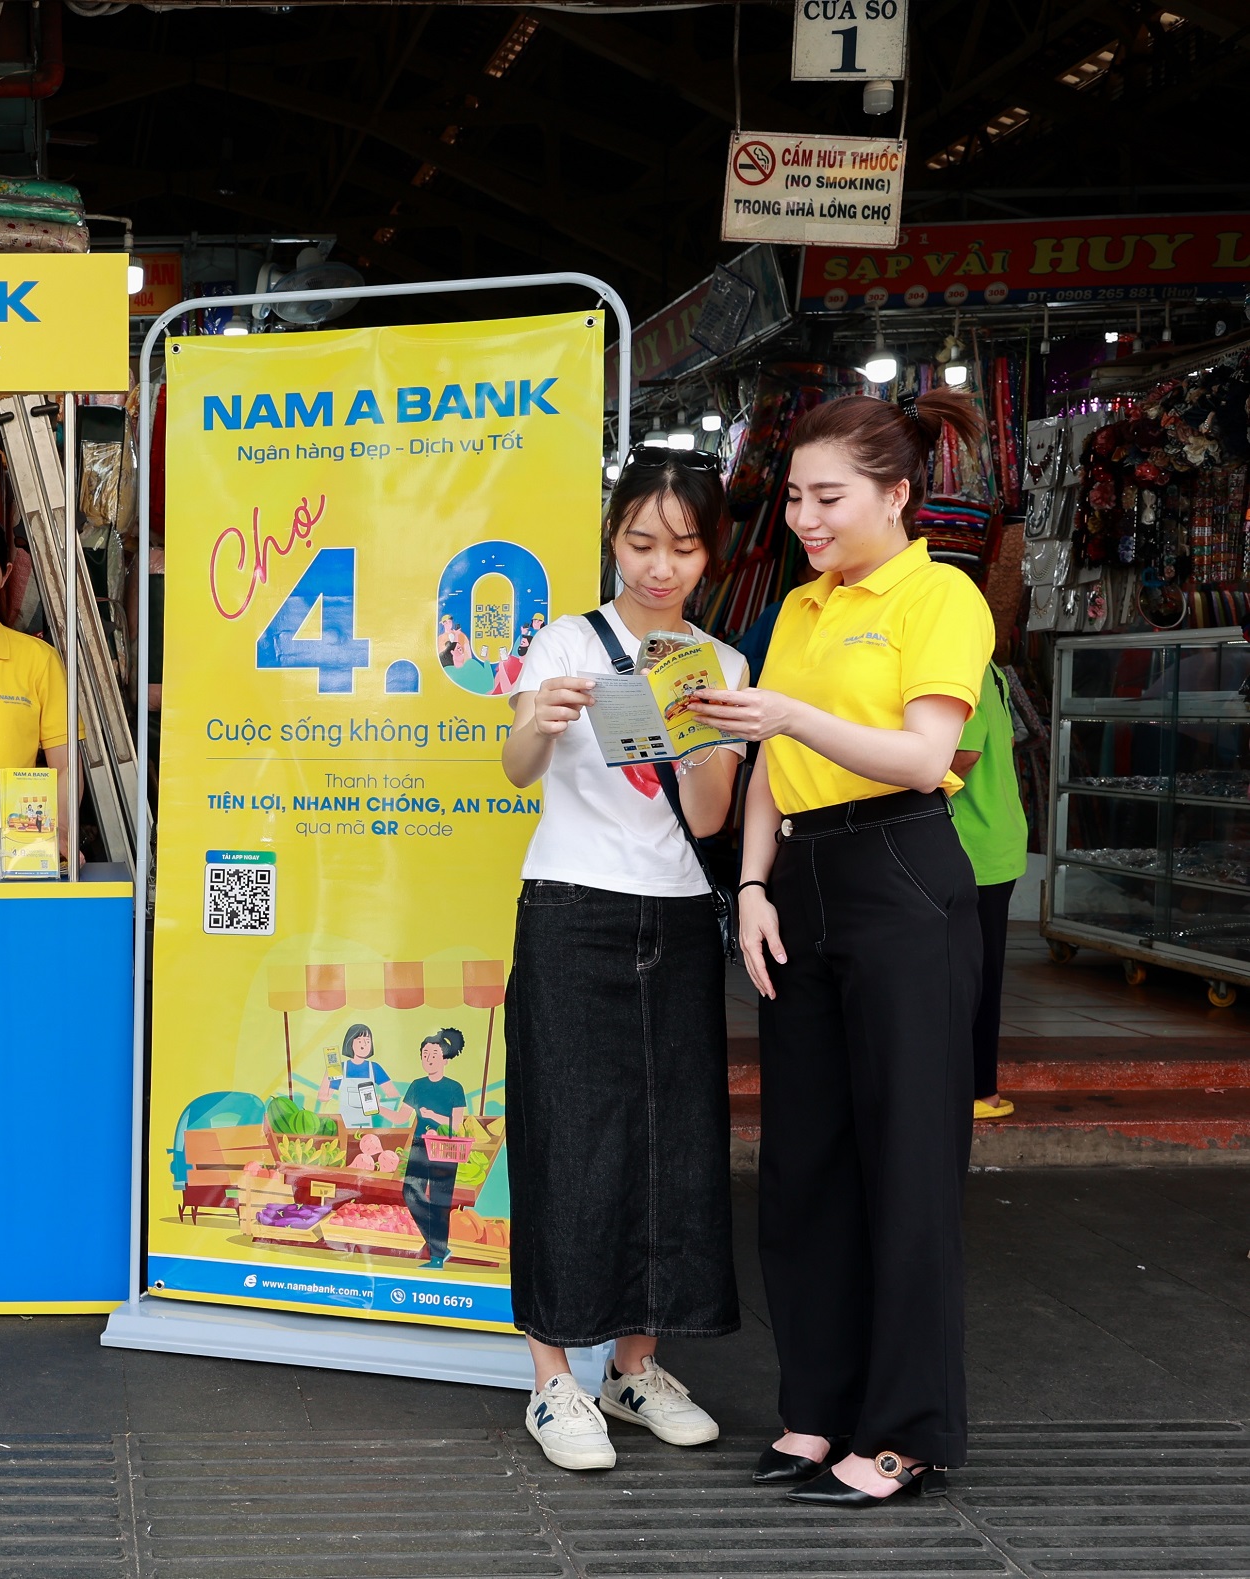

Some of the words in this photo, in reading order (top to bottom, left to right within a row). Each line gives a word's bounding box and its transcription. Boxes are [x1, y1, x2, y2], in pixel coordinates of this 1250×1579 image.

[830, 25, 867, 73] 1
[781, 141, 813, 167] CẤM
[816, 145, 846, 169] HÚT
[850, 146, 899, 172] THUỐC
[785, 174, 811, 190] (NO
[815, 176, 891, 194] SMOKING)
[733, 199, 781, 216] TRONG
[785, 198, 815, 217] NHÀ
[819, 197, 857, 220] LỒNG
[861, 203, 892, 225] CHỢ
[823, 253, 914, 285] SẠP
[923, 239, 1012, 277] VẢI
[1028, 233, 1196, 274] HUY
[134, 292, 154, 307] 404
[828, 295, 845, 303] 301
[868, 293, 885, 301] 302
[947, 290, 965, 298] 306
[988, 289, 1006, 297] 308
[1027, 291, 1052, 301] ĐT:
[1056, 289, 1093, 301] 0908
[1097, 288, 1125, 300] 265
[1129, 287, 1156, 299] 881
[1162, 286, 1198, 298] (Huy)
[203, 391, 333, 431] NAM
[344, 389, 385, 426] A
[396, 377, 561, 424] BANK
[237, 444, 290, 464] Ngân
[296, 442, 345, 462] hàng
[350, 441, 391, 460] Đẹp
[409, 437, 454, 457] Dịch
[459, 439, 484, 455] vụ
[487, 430, 523, 451] Tốt
[209, 494, 326, 620] Chợ
[255, 539, 550, 697] 4.0
[654, 660, 671, 675] NAM
[677, 647, 702, 658] BANK
[206, 718, 272, 746] Cuộc
[280, 716, 342, 747] sống
[350, 718, 429, 747] không
[437, 716, 486, 742] tiền
[325, 773, 377, 789] Thanh
[383, 772, 425, 789] toán
[207, 791, 245, 814] TIỆN
[251, 793, 286, 815] LỢI,
[293, 796, 360, 812] NHANH
[366, 793, 446, 815] CHÓNG,
[452, 798, 479, 813] AN
[296, 821, 331, 836] qua
[336, 819, 365, 835] mã
[371, 820, 399, 836] QR
[404, 820, 453, 837] code
[262, 1279, 374, 1298] www.namabank.com.vn
[411, 1292, 440, 1305] 1900
[443, 1294, 473, 1309] 6679
